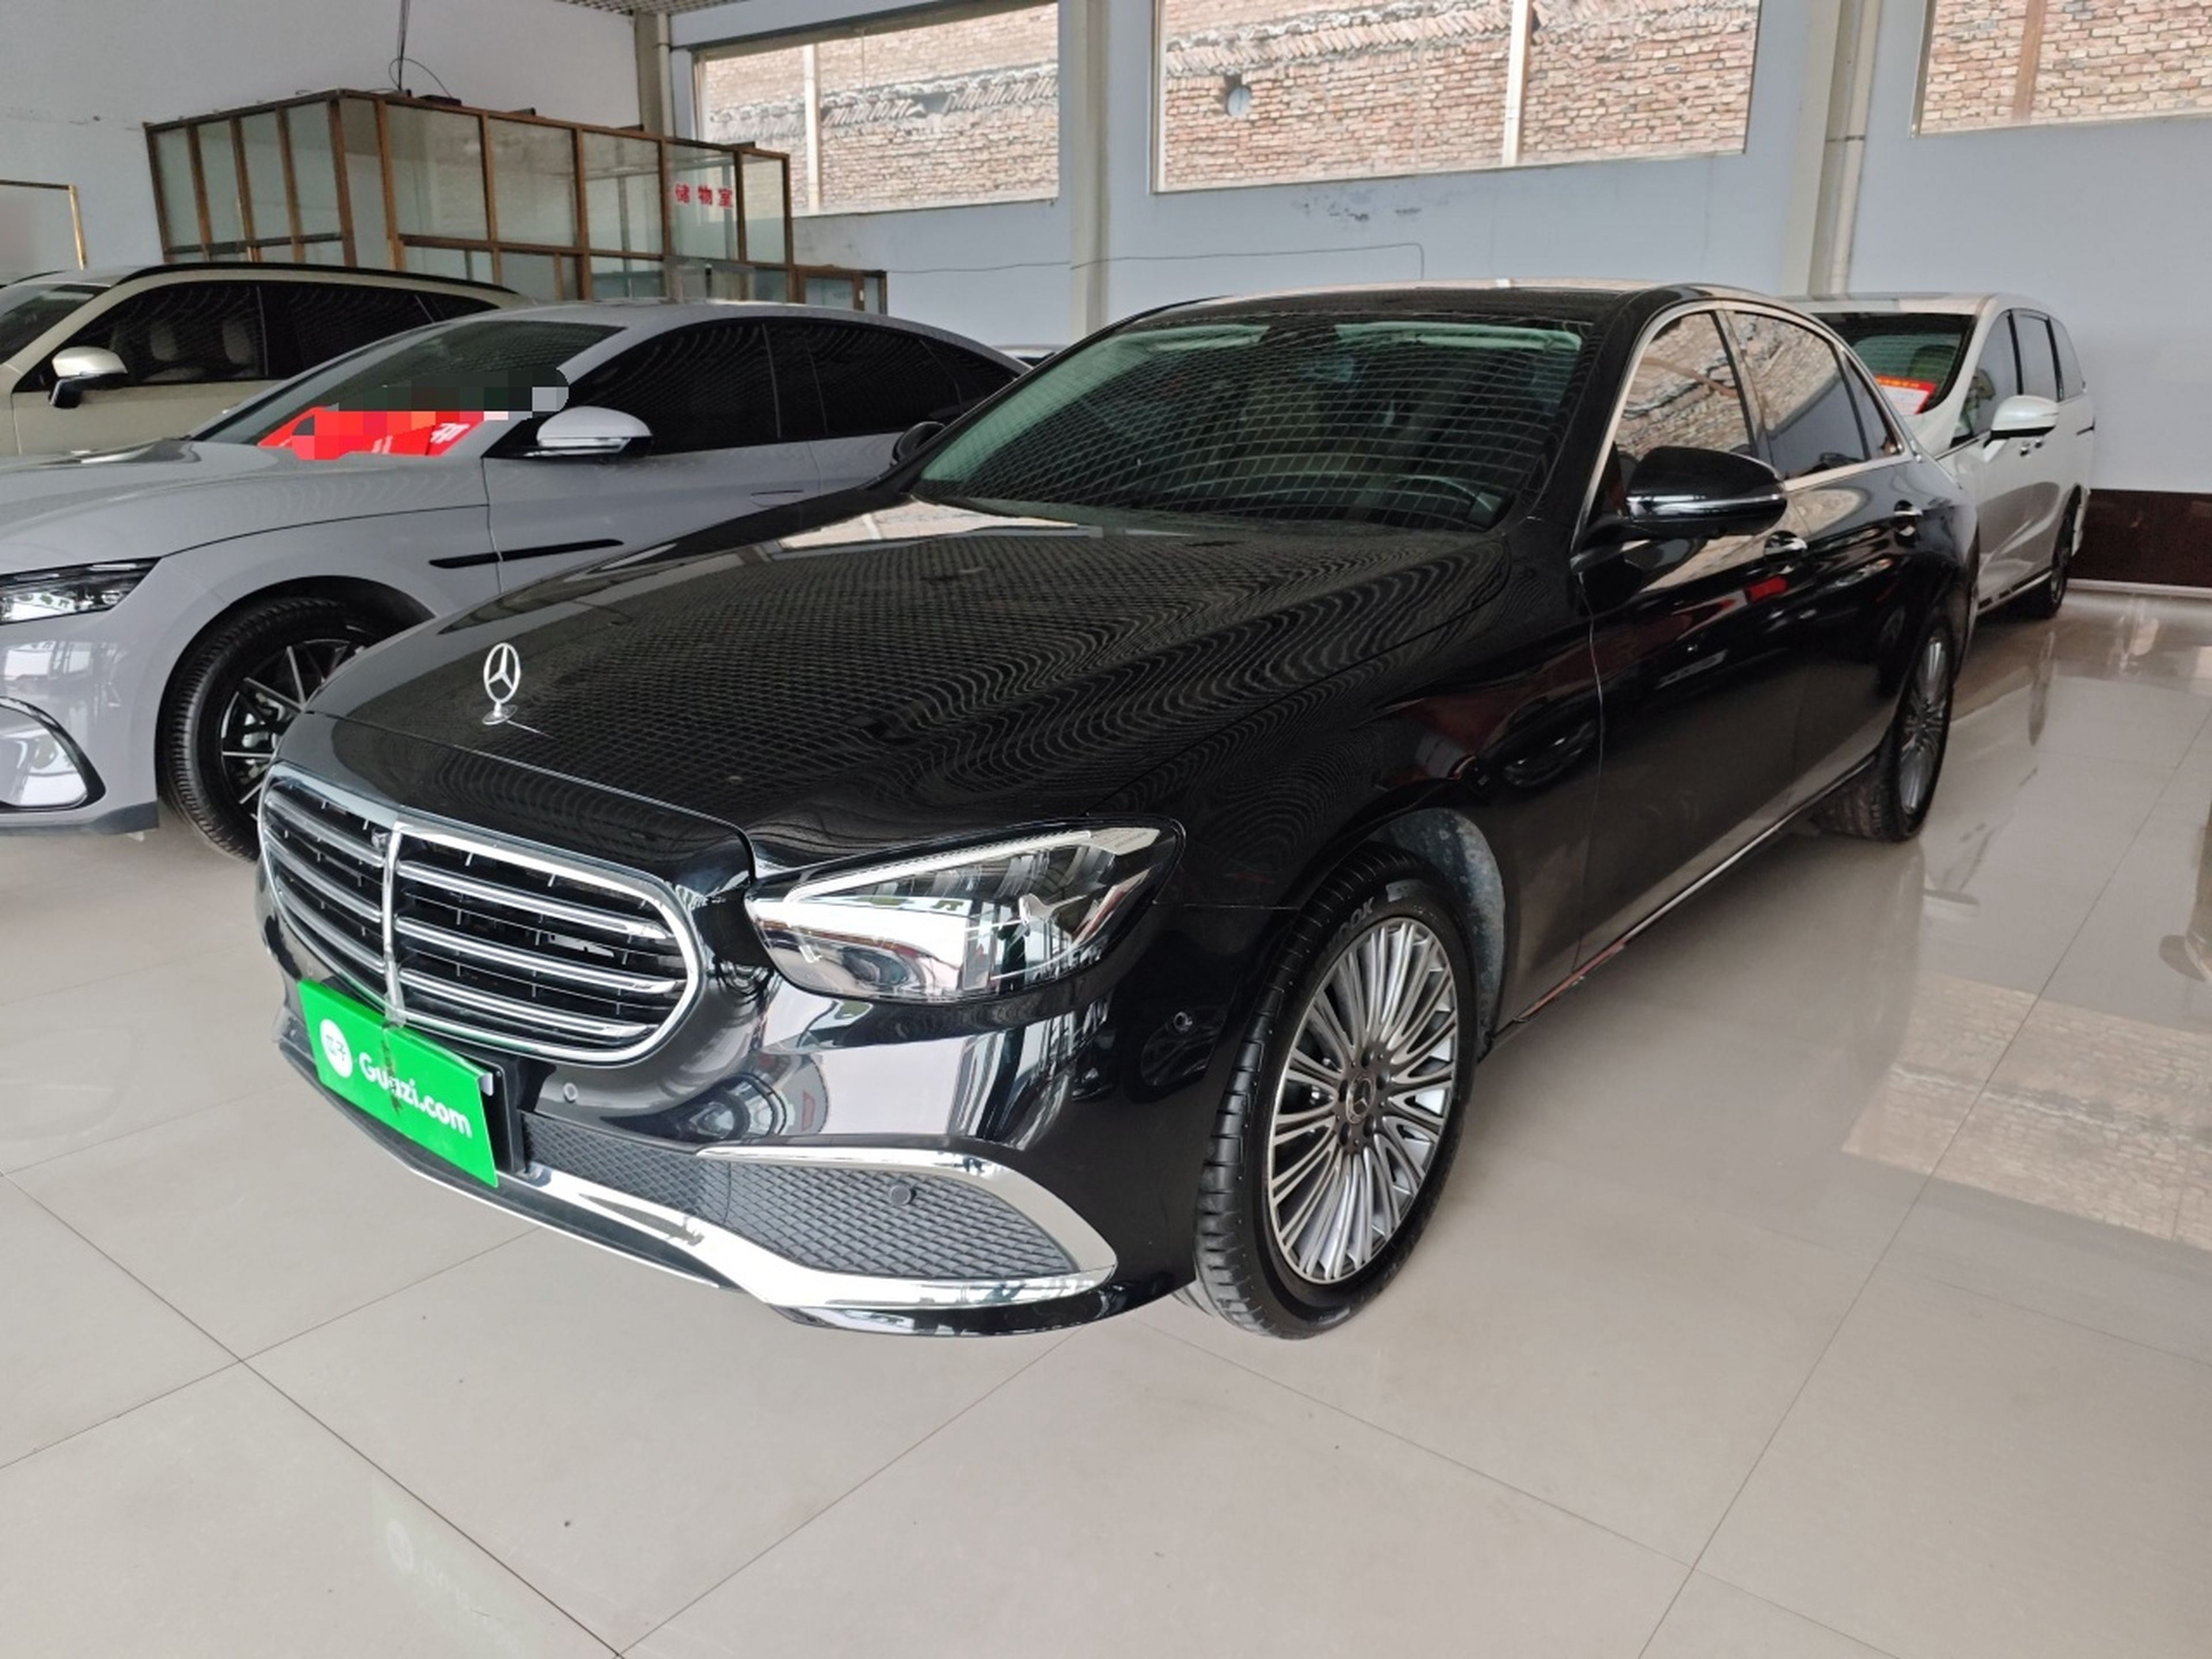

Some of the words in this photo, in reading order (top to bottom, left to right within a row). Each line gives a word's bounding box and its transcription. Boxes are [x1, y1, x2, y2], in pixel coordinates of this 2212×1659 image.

[675, 183, 733, 209] 储物室
[358, 1051, 472, 1139] Guazi.com
